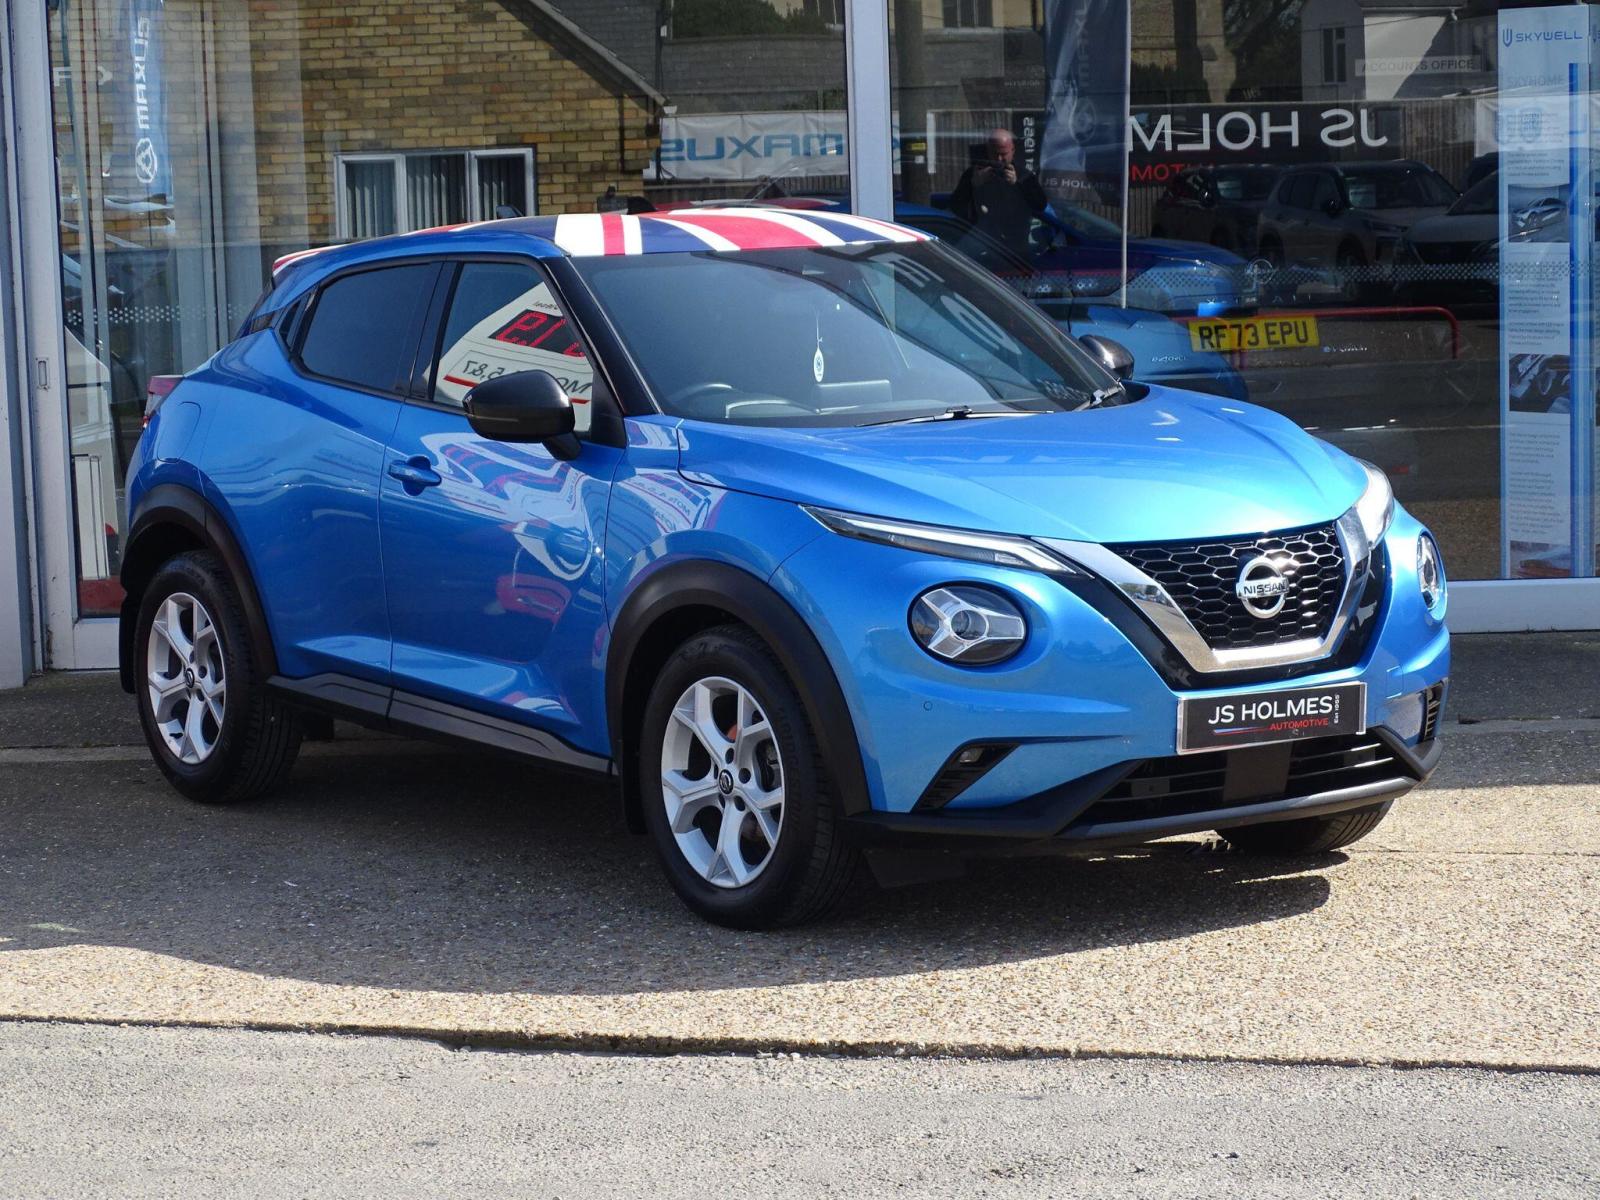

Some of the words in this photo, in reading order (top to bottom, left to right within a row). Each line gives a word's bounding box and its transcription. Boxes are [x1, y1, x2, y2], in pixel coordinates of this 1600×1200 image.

[1516, 31, 1583, 42] SKYWELL
[134, 16, 150, 129] MAXUS
[1431, 60, 1473, 71] OFFICE
[1198, 323, 1260, 349] RF73
[1264, 320, 1310, 346] EPU
[1244, 582, 1286, 595] NISSAN
[1208, 704, 1235, 725] JS
[1242, 696, 1333, 721] HOLMES
[1269, 717, 1329, 731] AUTOMOTIVE
